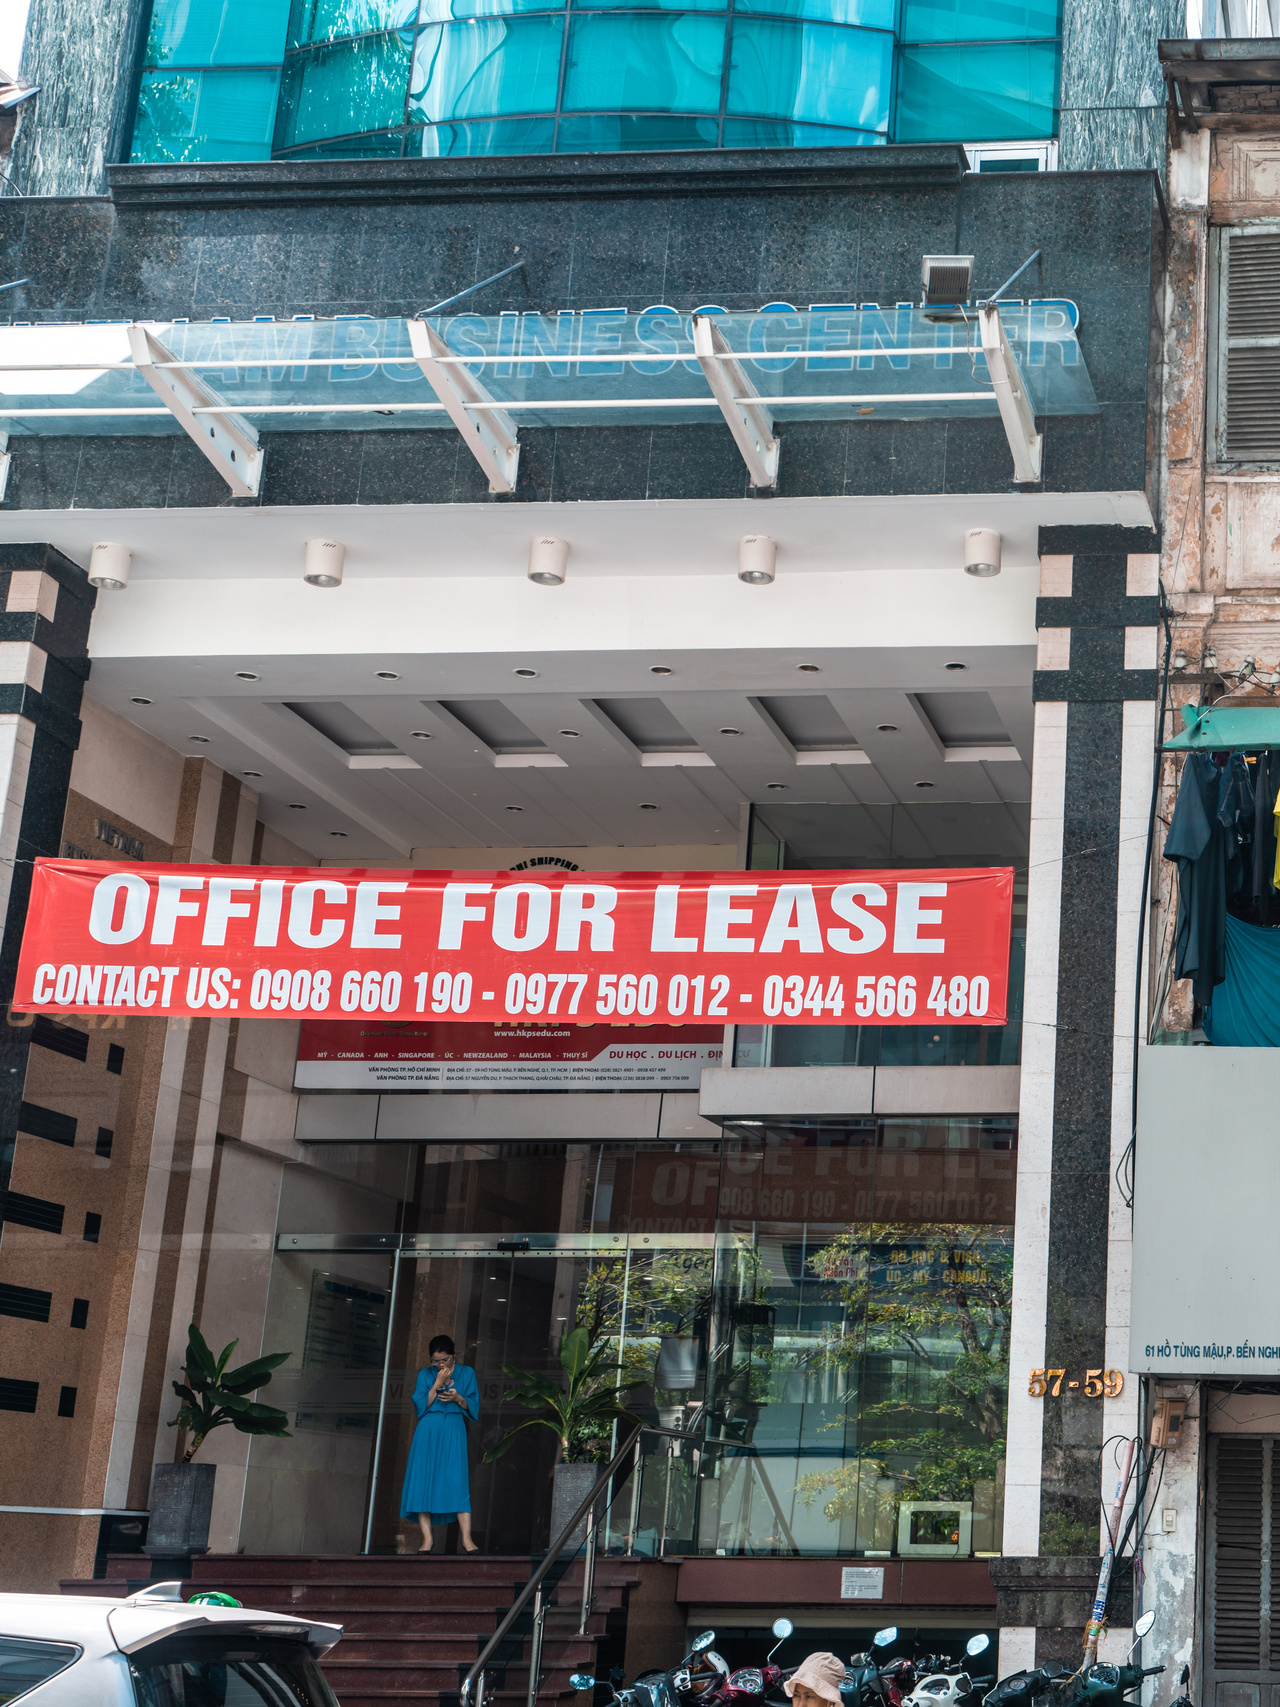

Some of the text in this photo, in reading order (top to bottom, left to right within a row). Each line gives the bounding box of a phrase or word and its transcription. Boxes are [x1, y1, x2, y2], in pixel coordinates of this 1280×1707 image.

[746, 298, 1081, 374] CENTER
[529, 856, 580, 872] SHIPPING
[88, 872, 949, 955] OFFICE FOR LEASE
[31, 962, 990, 1018] CONTACT US: 0908 660 190 0977 560 012 0344 566 480
[494, 1029, 571, 1038] www.hkpsedu.com
[609, 1050, 625, 1059] DU
[626, 1050, 648, 1061] HỌC
[658, 1050, 674, 1059] DU
[674, 1050, 697, 1061] LỊCH
[1145, 1344, 1156, 1358] 61
[1156, 1339, 1171, 1358] HỒ
[1173, 1341, 1201, 1358] TÙNG
